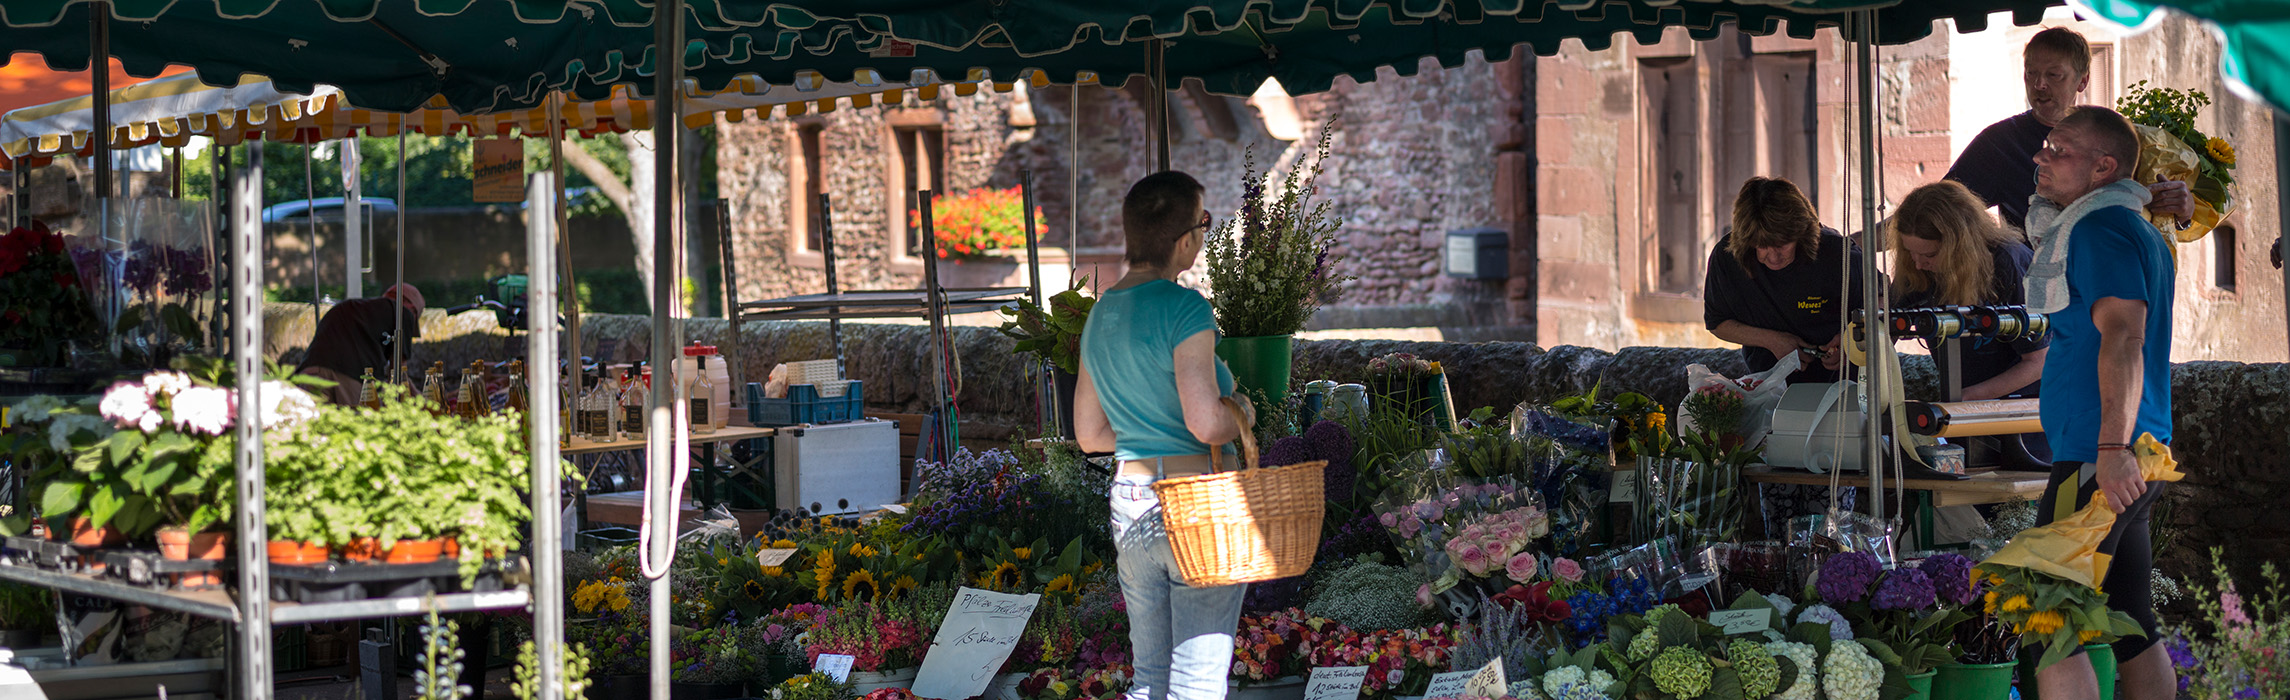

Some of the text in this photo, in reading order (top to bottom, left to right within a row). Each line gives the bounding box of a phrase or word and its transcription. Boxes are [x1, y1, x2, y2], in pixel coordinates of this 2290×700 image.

[474, 155, 523, 179] schneider
[953, 627, 979, 646] 15
[1312, 682, 1326, 695] 12
